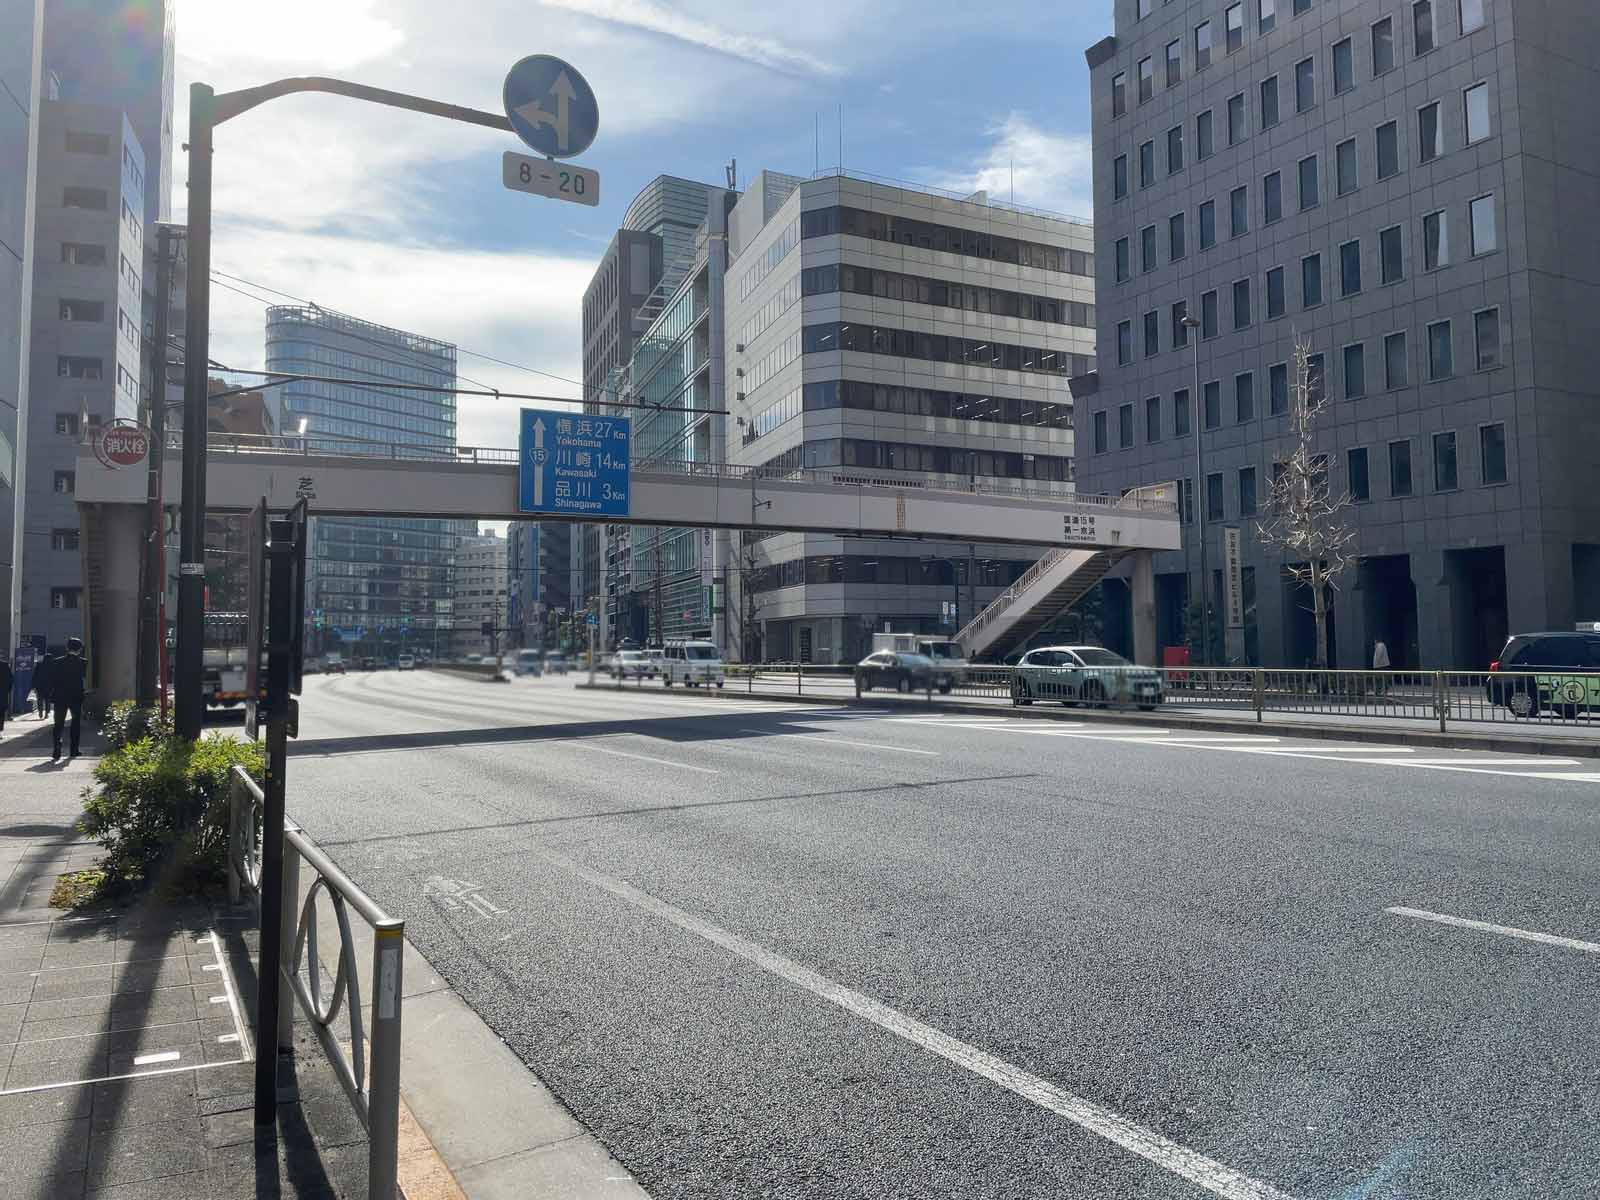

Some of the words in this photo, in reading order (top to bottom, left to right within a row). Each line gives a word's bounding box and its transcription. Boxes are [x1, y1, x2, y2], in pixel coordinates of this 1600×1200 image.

[556, 419, 593, 437] 横浜
[106, 437, 145, 455] 消火栓
[556, 436, 602, 448] Yokohama
[532, 451, 545, 462] 15
[556, 448, 593, 468] 川崎
[555, 467, 597, 479] Kawasaki
[555, 480, 592, 498] 品川
[554, 498, 602, 510] Shinagawa
